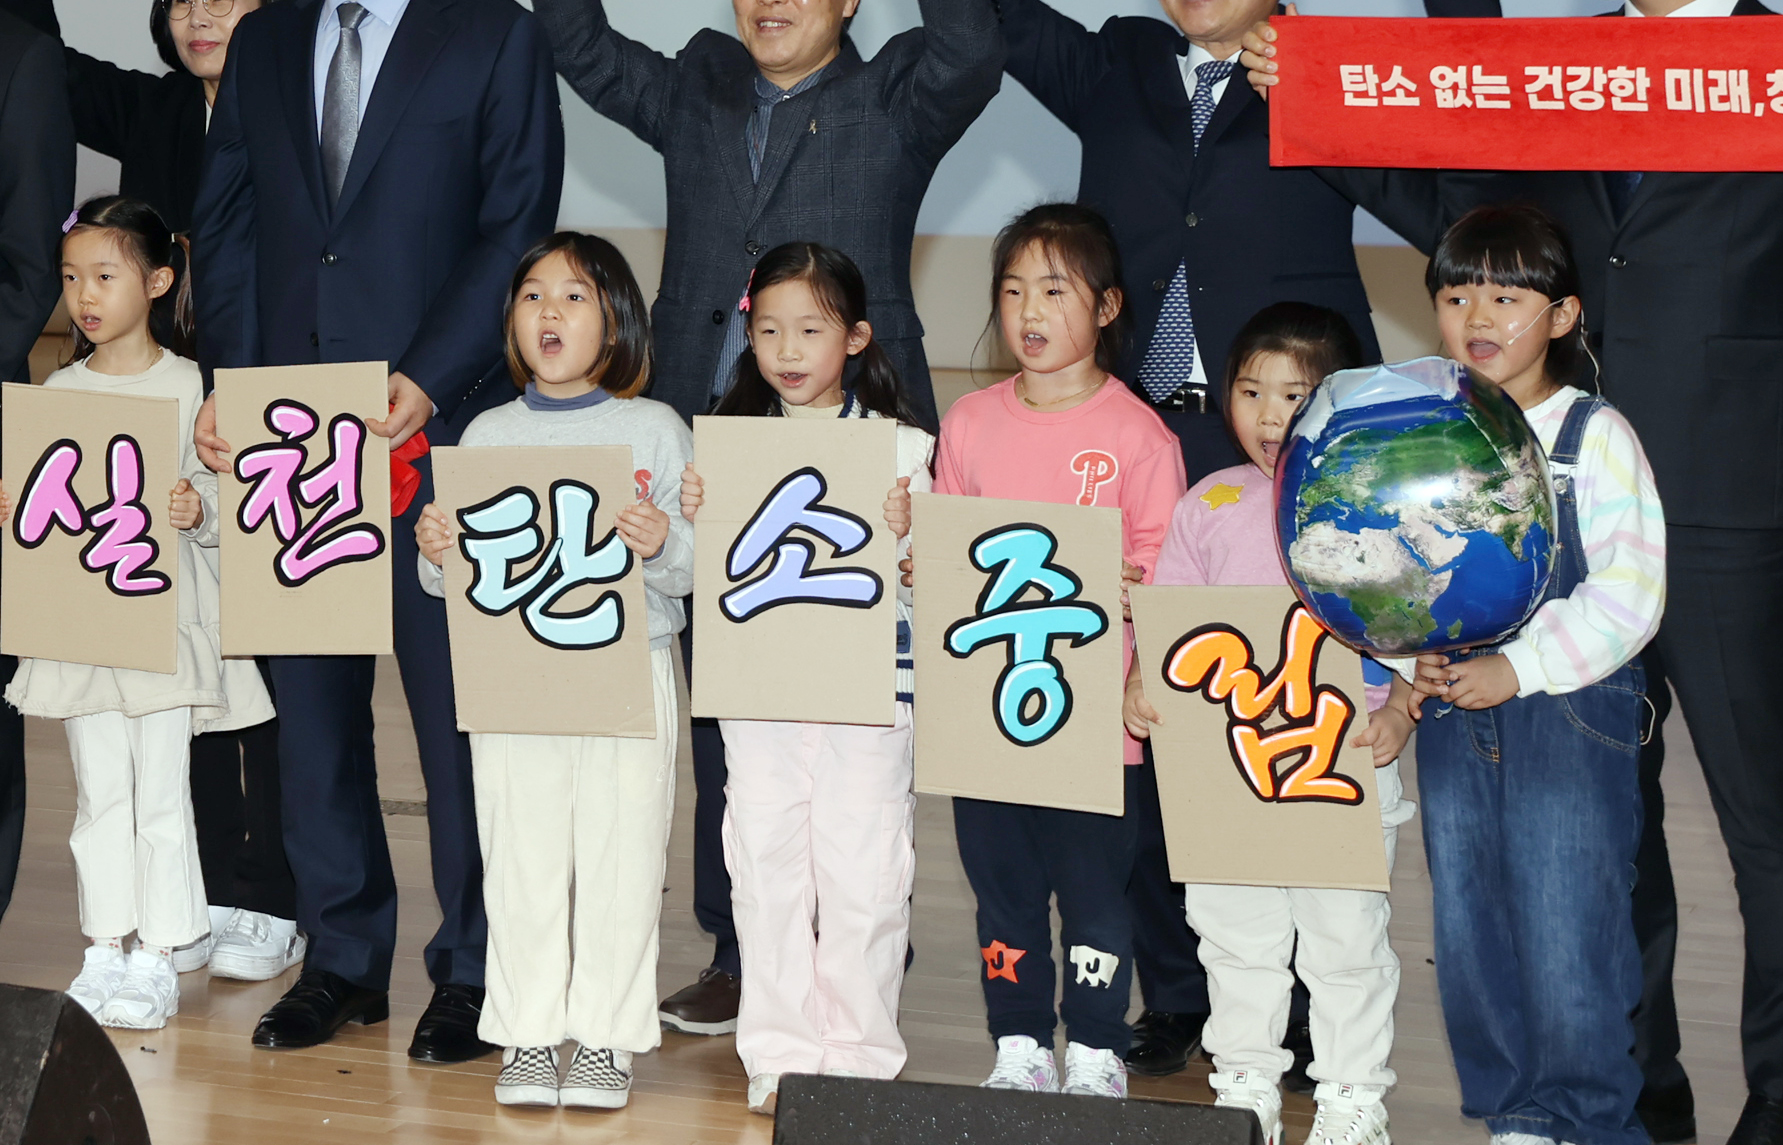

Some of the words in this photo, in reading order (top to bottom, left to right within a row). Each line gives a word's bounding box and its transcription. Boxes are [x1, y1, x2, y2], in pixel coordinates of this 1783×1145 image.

[1340, 64, 1420, 107] 탄소
[1429, 64, 1511, 109] 없는
[1524, 65, 1650, 112] 건강한
[13, 434, 171, 596] 실
[234, 398, 385, 587] 천
[457, 478, 633, 649] 탄
[719, 466, 883, 622] 소
[945, 522, 1108, 747] 중
